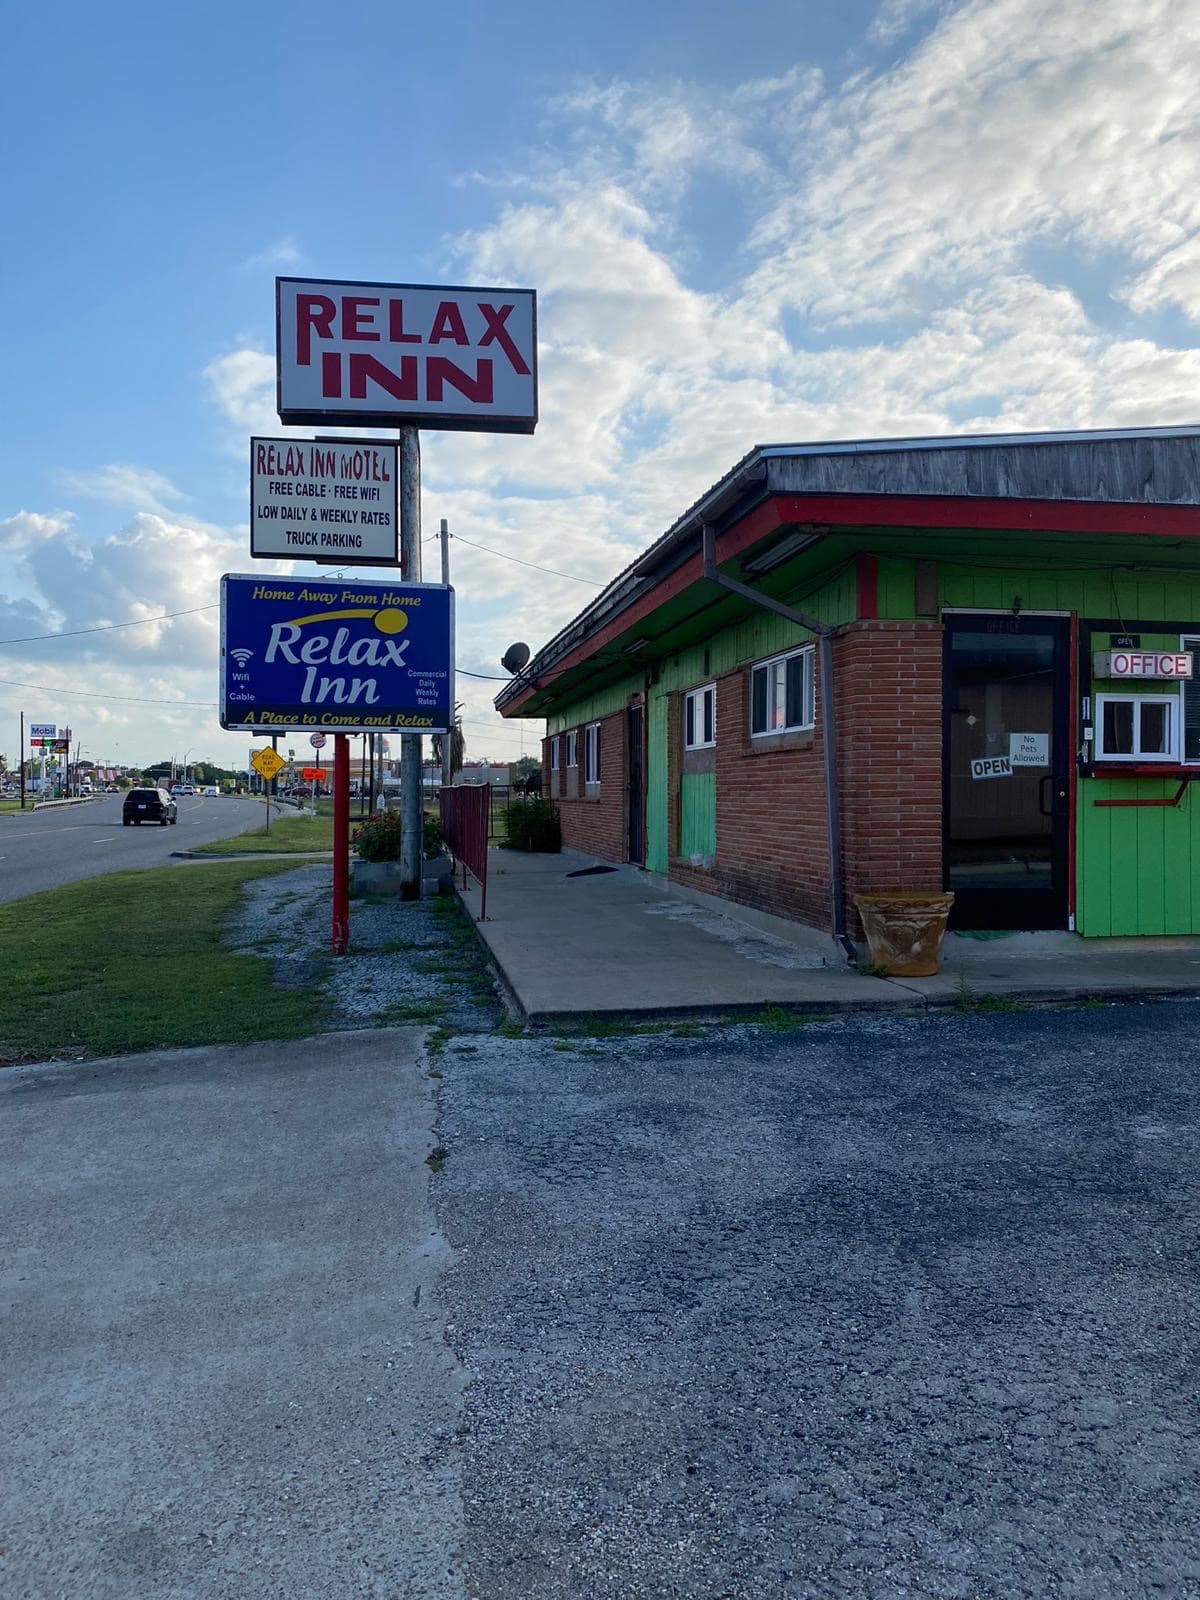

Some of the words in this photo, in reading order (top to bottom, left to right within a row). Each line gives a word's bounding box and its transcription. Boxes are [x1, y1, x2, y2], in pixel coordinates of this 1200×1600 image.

[296, 293, 532, 375] RELAX
[322, 352, 494, 404] INN
[257, 444, 305, 477] RELAX
[310, 447, 336, 479] INN
[340, 449, 390, 482] MOTEL
[269, 481, 293, 496] FREE
[295, 483, 326, 498] CABLE
[334, 485, 358, 500] FREE
[360, 487, 380, 501] WIFI
[258, 505, 279, 519] LOW
[281, 506, 308, 521] DAILY
[310, 508, 317, 521] &
[320, 508, 358, 524] WEEKLY
[361, 511, 390, 526] RATES
[286, 531, 318, 546] TRUCK
[320, 533, 362, 548] PARKING
[252, 586, 295, 600] Home
[298, 588, 337, 605] Away
[341, 591, 378, 604] From
[381, 593, 422, 606] Home
[264, 622, 411, 667] Relax
[1113, 654, 1188, 676] OFFICE
[232, 673, 250, 681] Wifi
[407, 669, 447, 678] Commercial
[300, 666, 379, 704] Inn
[419, 679, 436, 688] Daily
[229, 692, 256, 701] Cable
[415, 688, 439, 698] Weekly
[417, 697, 437, 705] Rates
[243, 711, 256, 724] A
[259, 712, 299, 724] Place
[302, 713, 318, 725] to
[320, 713, 360, 726] Come
[363, 714, 392, 726] and
[394, 713, 434, 727] Relax
[32, 727, 55, 735] Mobil
[1023, 735, 1036, 743] No
[1020, 745, 1038, 753] Pets
[1013, 754, 1046, 763] Allowed
[973, 759, 1011, 776] OPEN
